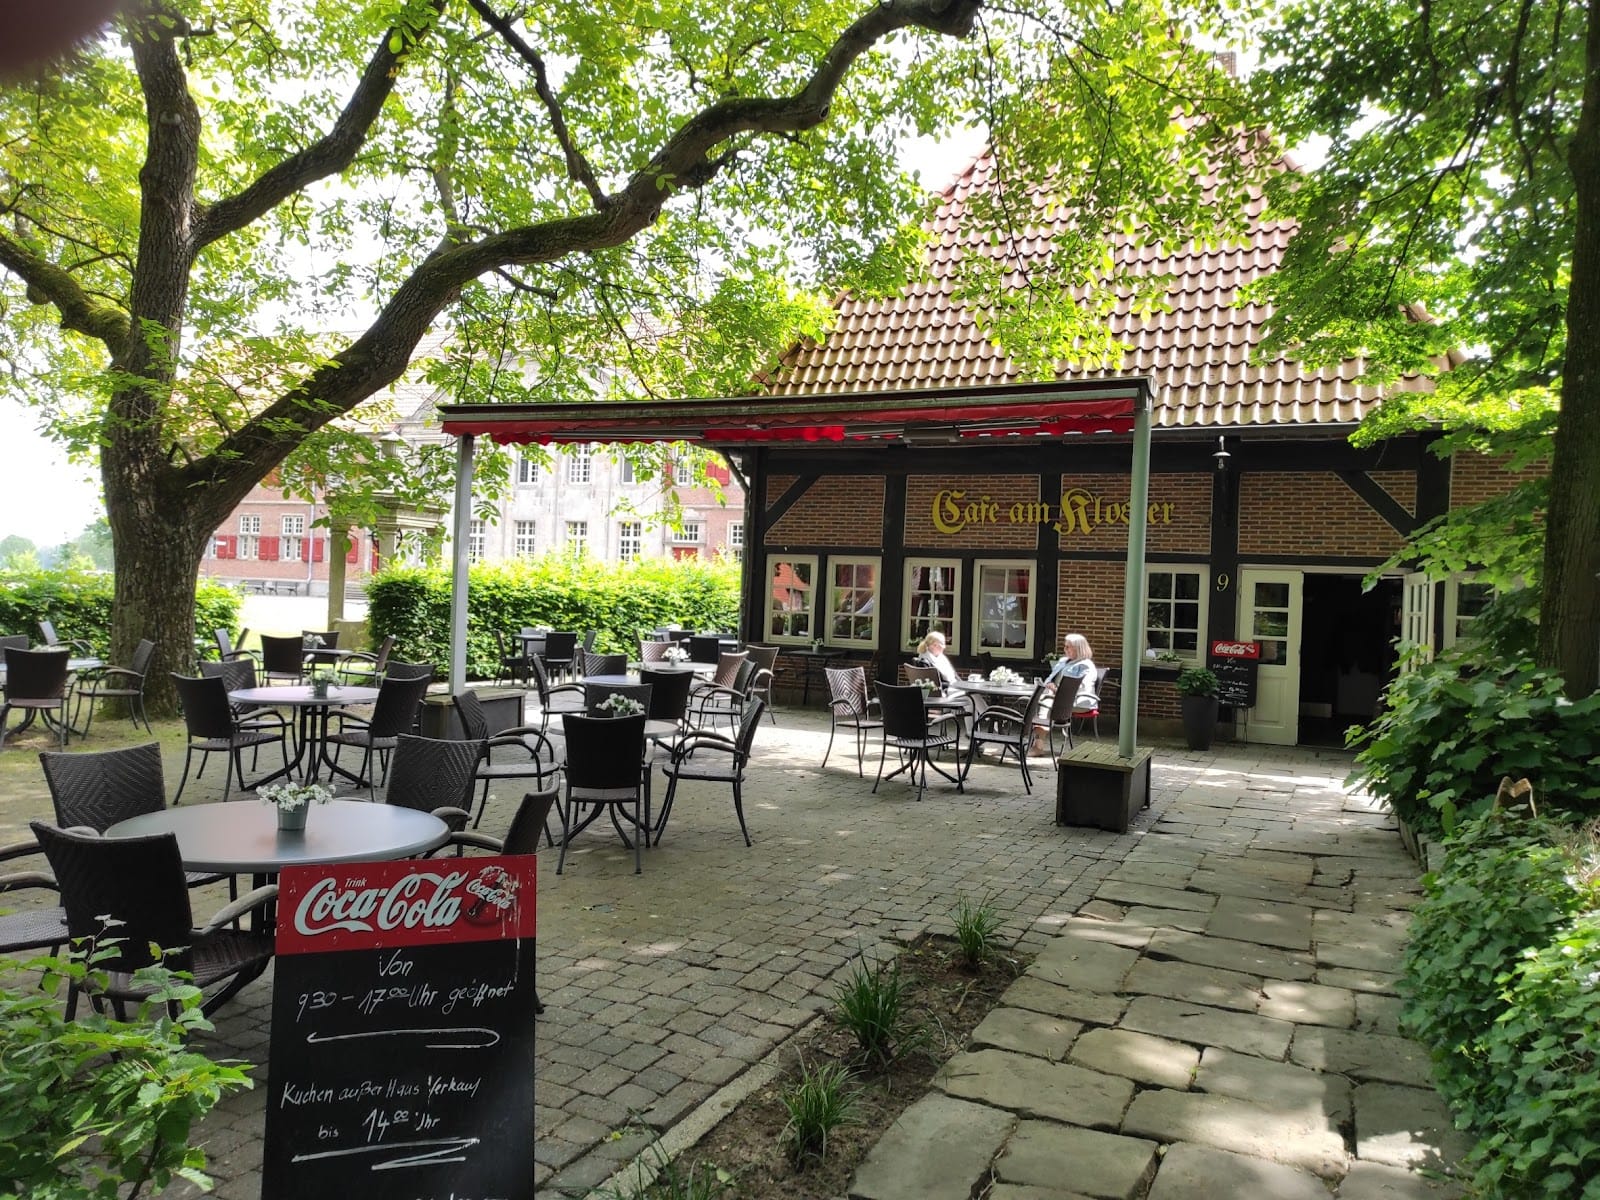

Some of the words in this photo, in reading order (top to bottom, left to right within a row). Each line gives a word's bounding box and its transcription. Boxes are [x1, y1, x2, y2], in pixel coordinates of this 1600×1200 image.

[1009, 501, 1050, 525] am
[1053, 487, 1176, 536] Kloser
[1216, 573, 1229, 592] 9
[344, 877, 367, 888] Trink
[294, 870, 469, 936] Coca-Cola
[378, 949, 414, 977] Von
[409, 982, 438, 1008] Uhr
[280, 1081, 334, 1109] Kuchen
[385, 1078, 420, 1098] Haus
[318, 1124, 339, 1140] bis
